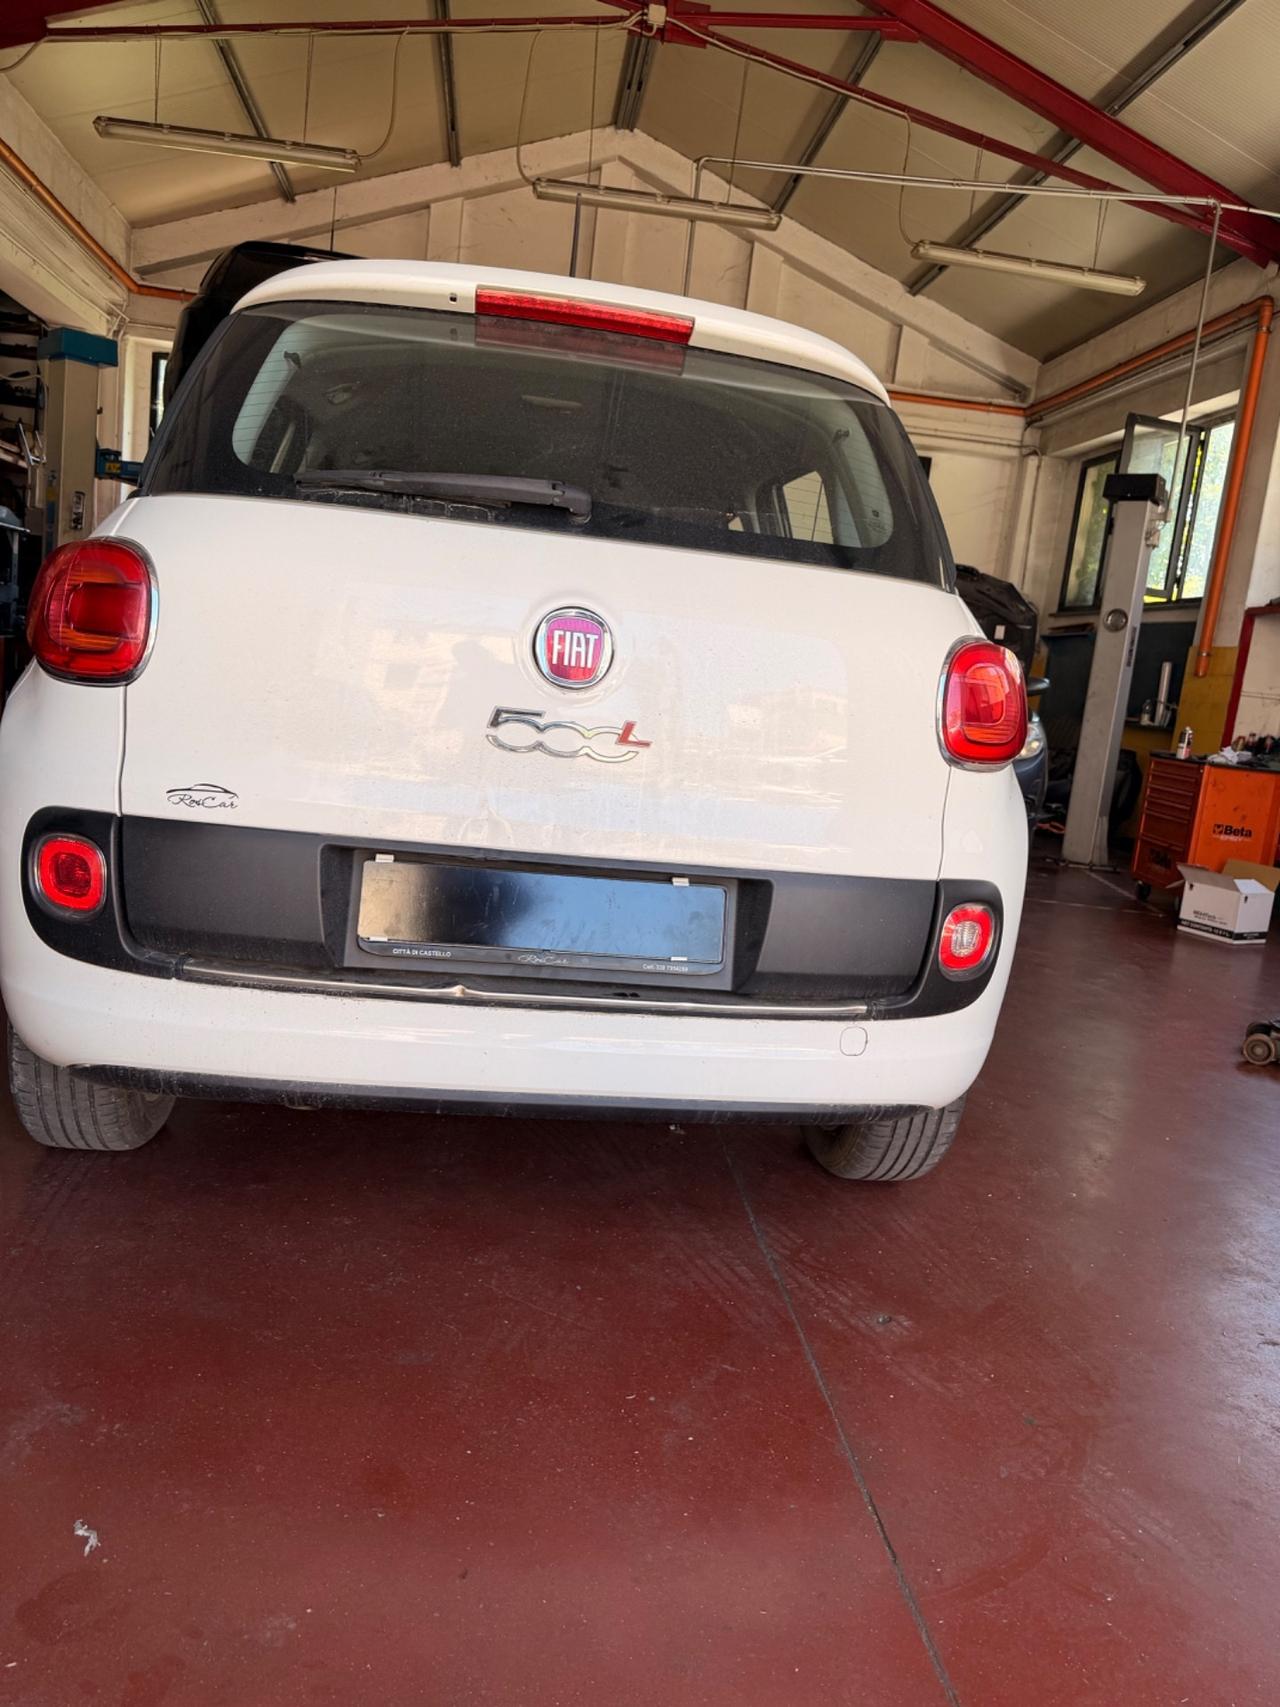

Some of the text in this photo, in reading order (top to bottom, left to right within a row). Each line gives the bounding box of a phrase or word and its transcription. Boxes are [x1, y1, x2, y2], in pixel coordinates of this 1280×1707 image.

[552, 629, 599, 669] FIAT
[485, 705, 653, 764] 500L
[1223, 824, 1252, 838] Beta
[419, 949, 452, 958] CASTELLO
